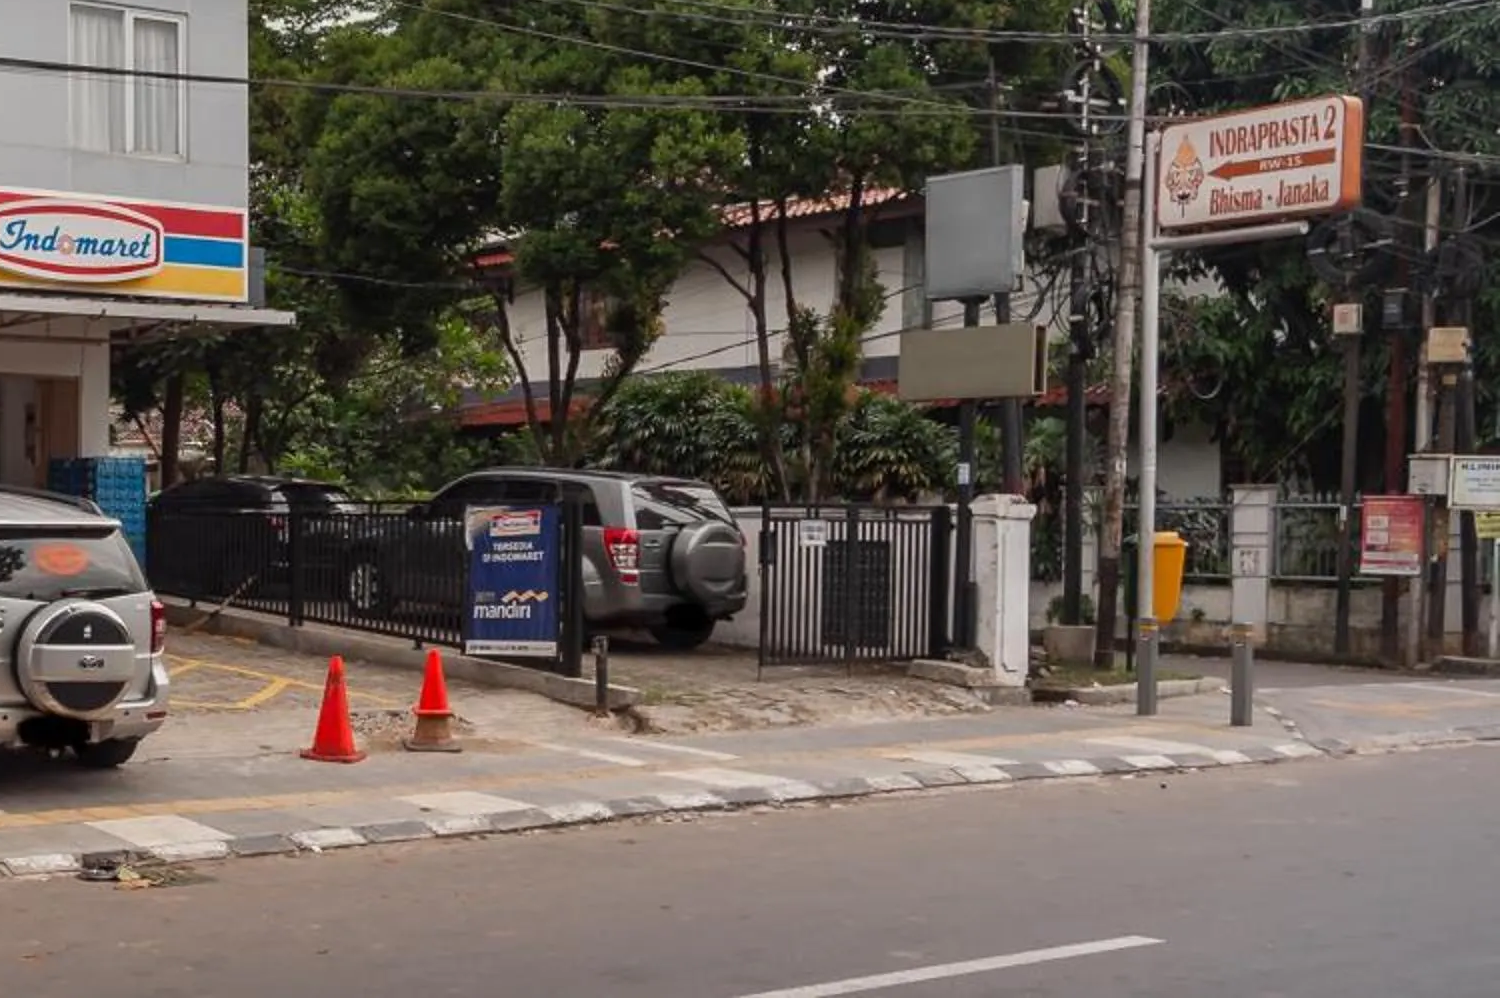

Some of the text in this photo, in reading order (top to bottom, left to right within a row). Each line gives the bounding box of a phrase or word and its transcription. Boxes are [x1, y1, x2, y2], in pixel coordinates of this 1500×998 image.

[1209, 105, 1337, 158] INDRAPRASTA 2
[1209, 175, 1329, 215] Bhisma Janaka
[0, 219, 151, 259] Indomaret
[473, 601, 532, 619] mandiri
